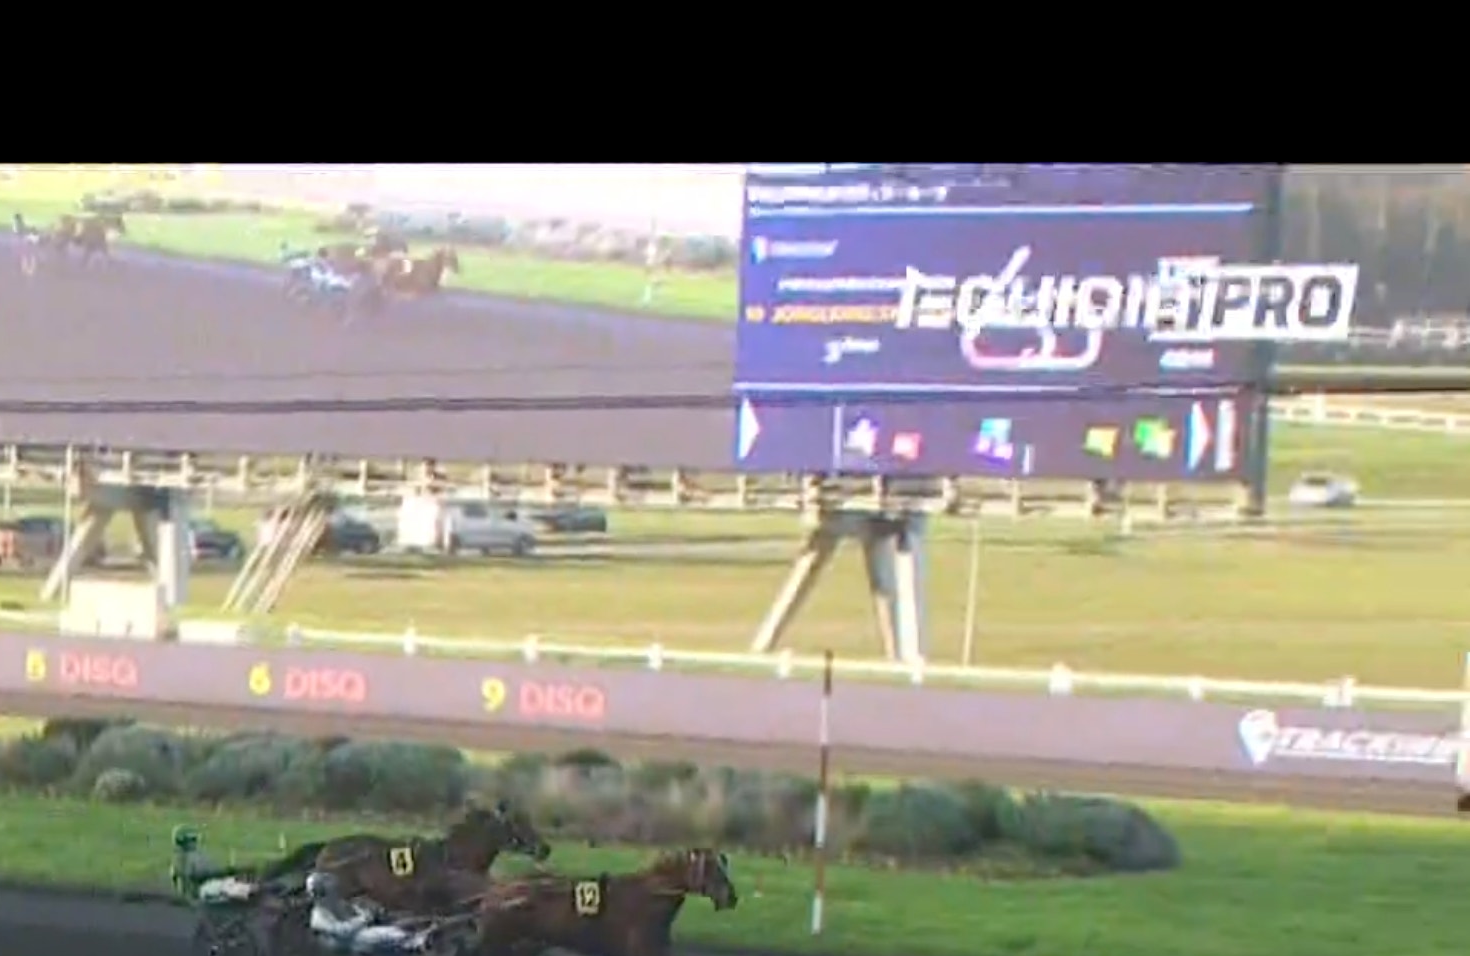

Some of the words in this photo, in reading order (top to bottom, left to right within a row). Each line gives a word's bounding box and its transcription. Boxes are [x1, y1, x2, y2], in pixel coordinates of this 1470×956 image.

[60, 652, 139, 687] DISQ
[285, 667, 366, 703] DISQ
[481, 676, 506, 713] 9
[519, 682, 605, 718] DISQ
[578, 885, 600, 911] 12
